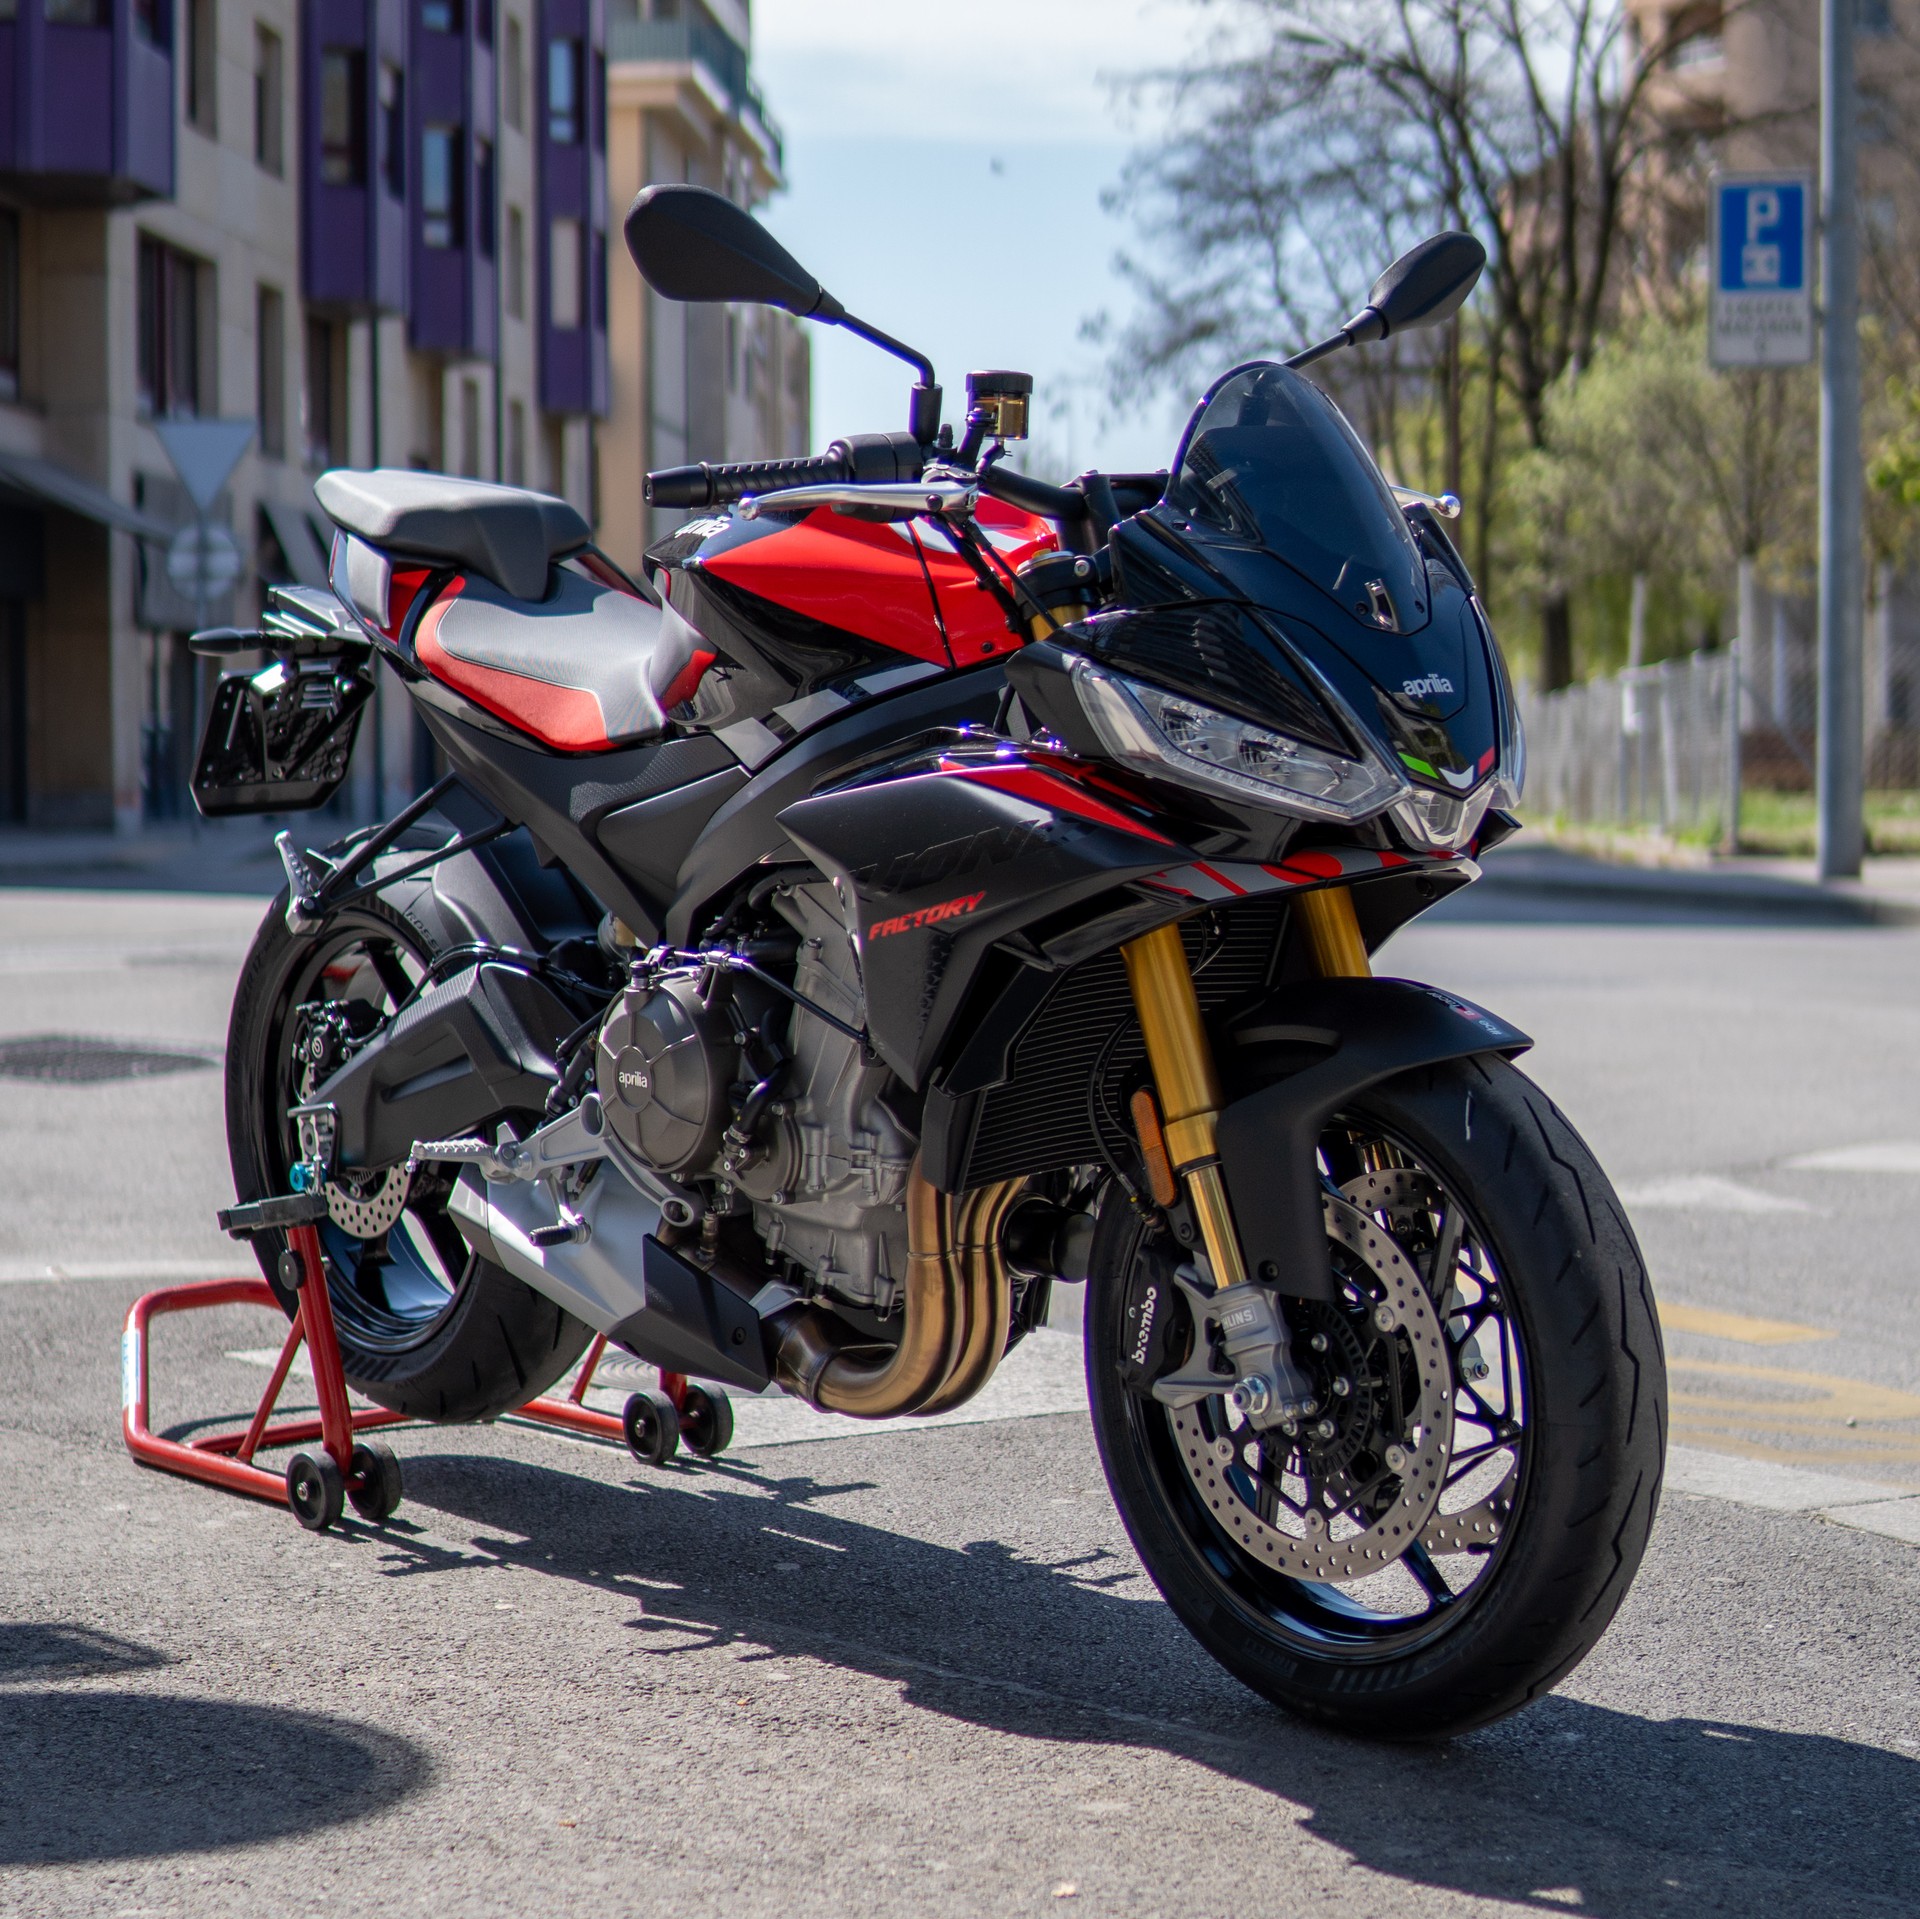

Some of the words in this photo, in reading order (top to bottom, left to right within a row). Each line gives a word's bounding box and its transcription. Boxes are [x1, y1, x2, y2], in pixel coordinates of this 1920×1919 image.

[1747, 191, 1780, 241] P
[1402, 673, 1454, 698] aprilia
[868, 890, 987, 941] FACTORY
[618, 1071, 648, 1089] aprilia
[1131, 1286, 1158, 1365] brembo
[1221, 1309, 1253, 1330] HLINS
